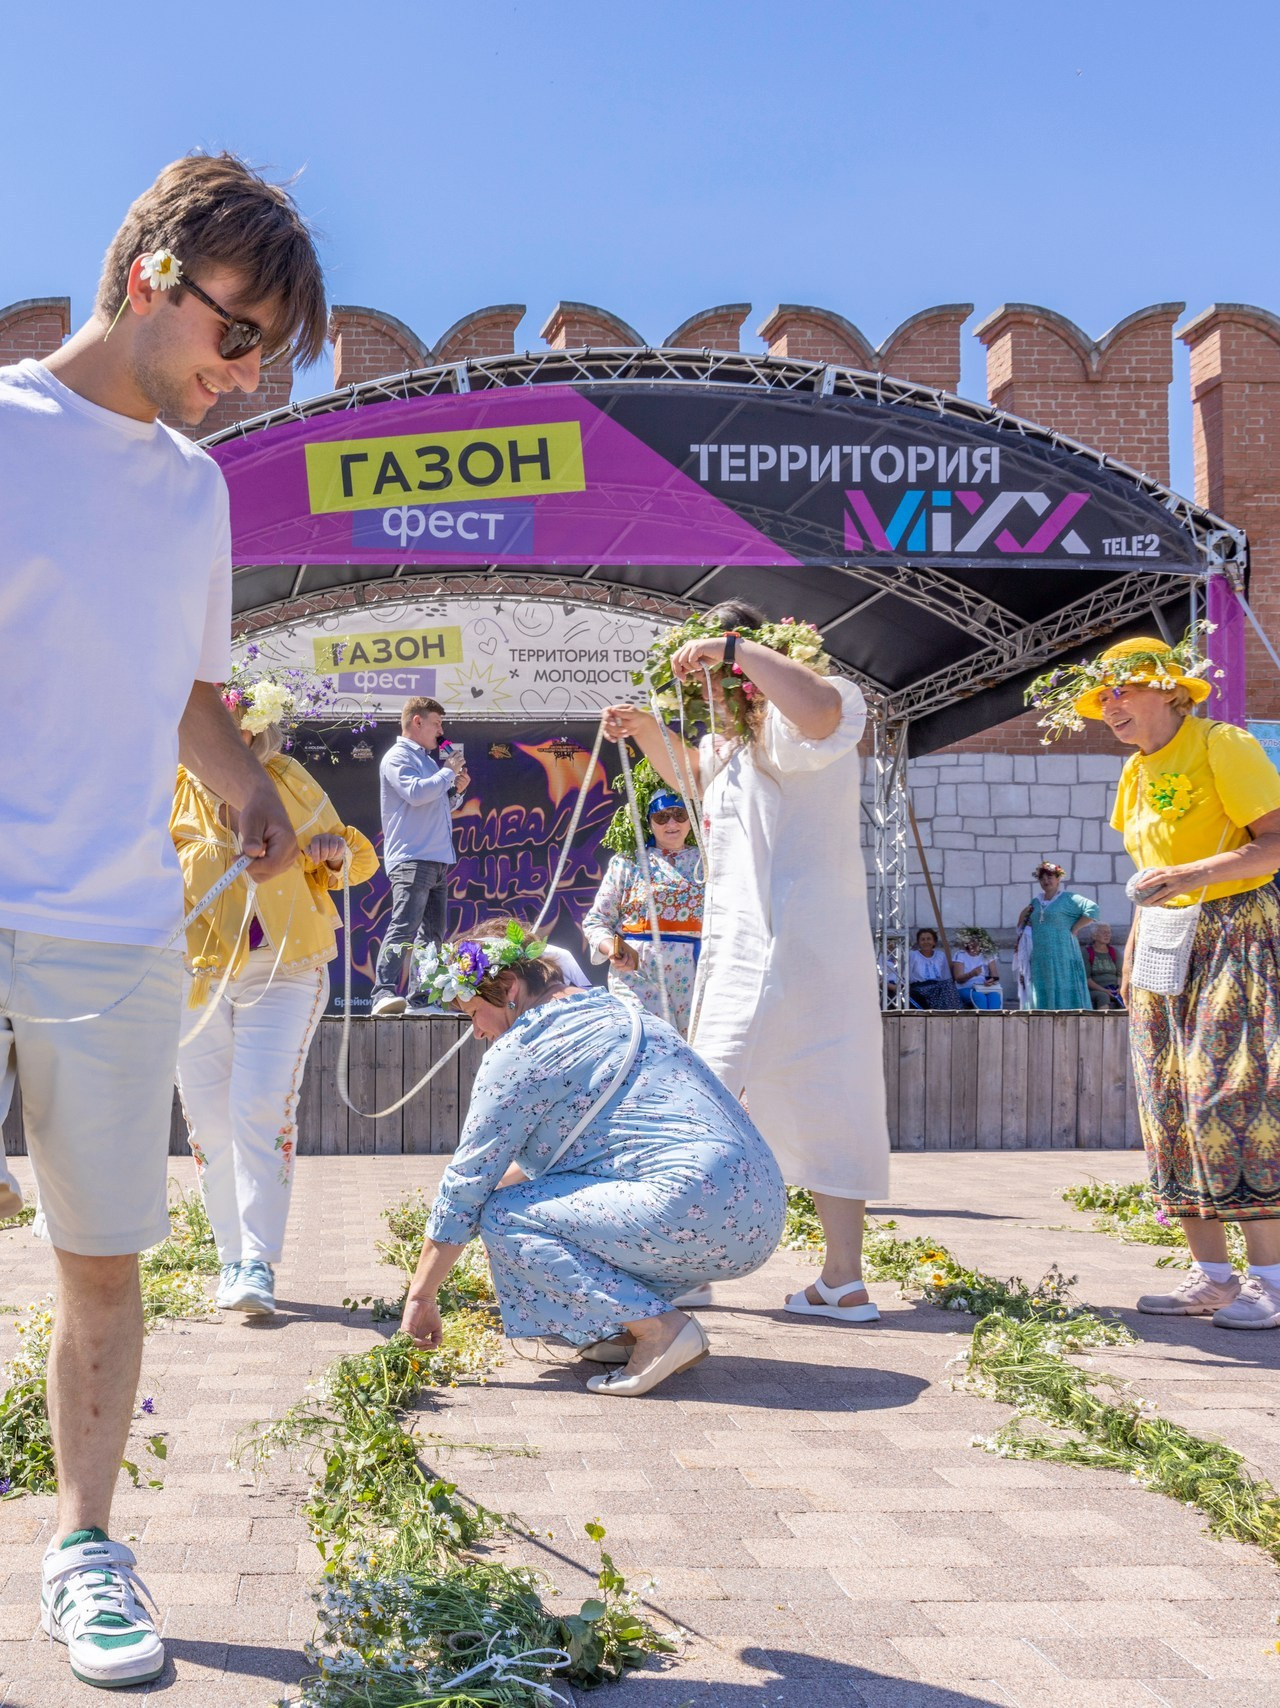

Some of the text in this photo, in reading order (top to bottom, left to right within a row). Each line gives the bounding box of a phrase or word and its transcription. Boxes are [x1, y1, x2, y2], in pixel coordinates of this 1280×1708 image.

[340, 437, 551, 498] ГАЗОН
[689, 444, 1000, 484] ТЕРРИТОРИЯ
[382, 505, 505, 547] фест
[1102, 533, 1160, 557] TELE2
[331, 634, 445, 667] ГАЗОН
[509, 648, 609, 663] ТЕРРИТОРИЯ
[354, 670, 420, 692] фест
[534, 669, 636, 684] МОЛОДОСТ
